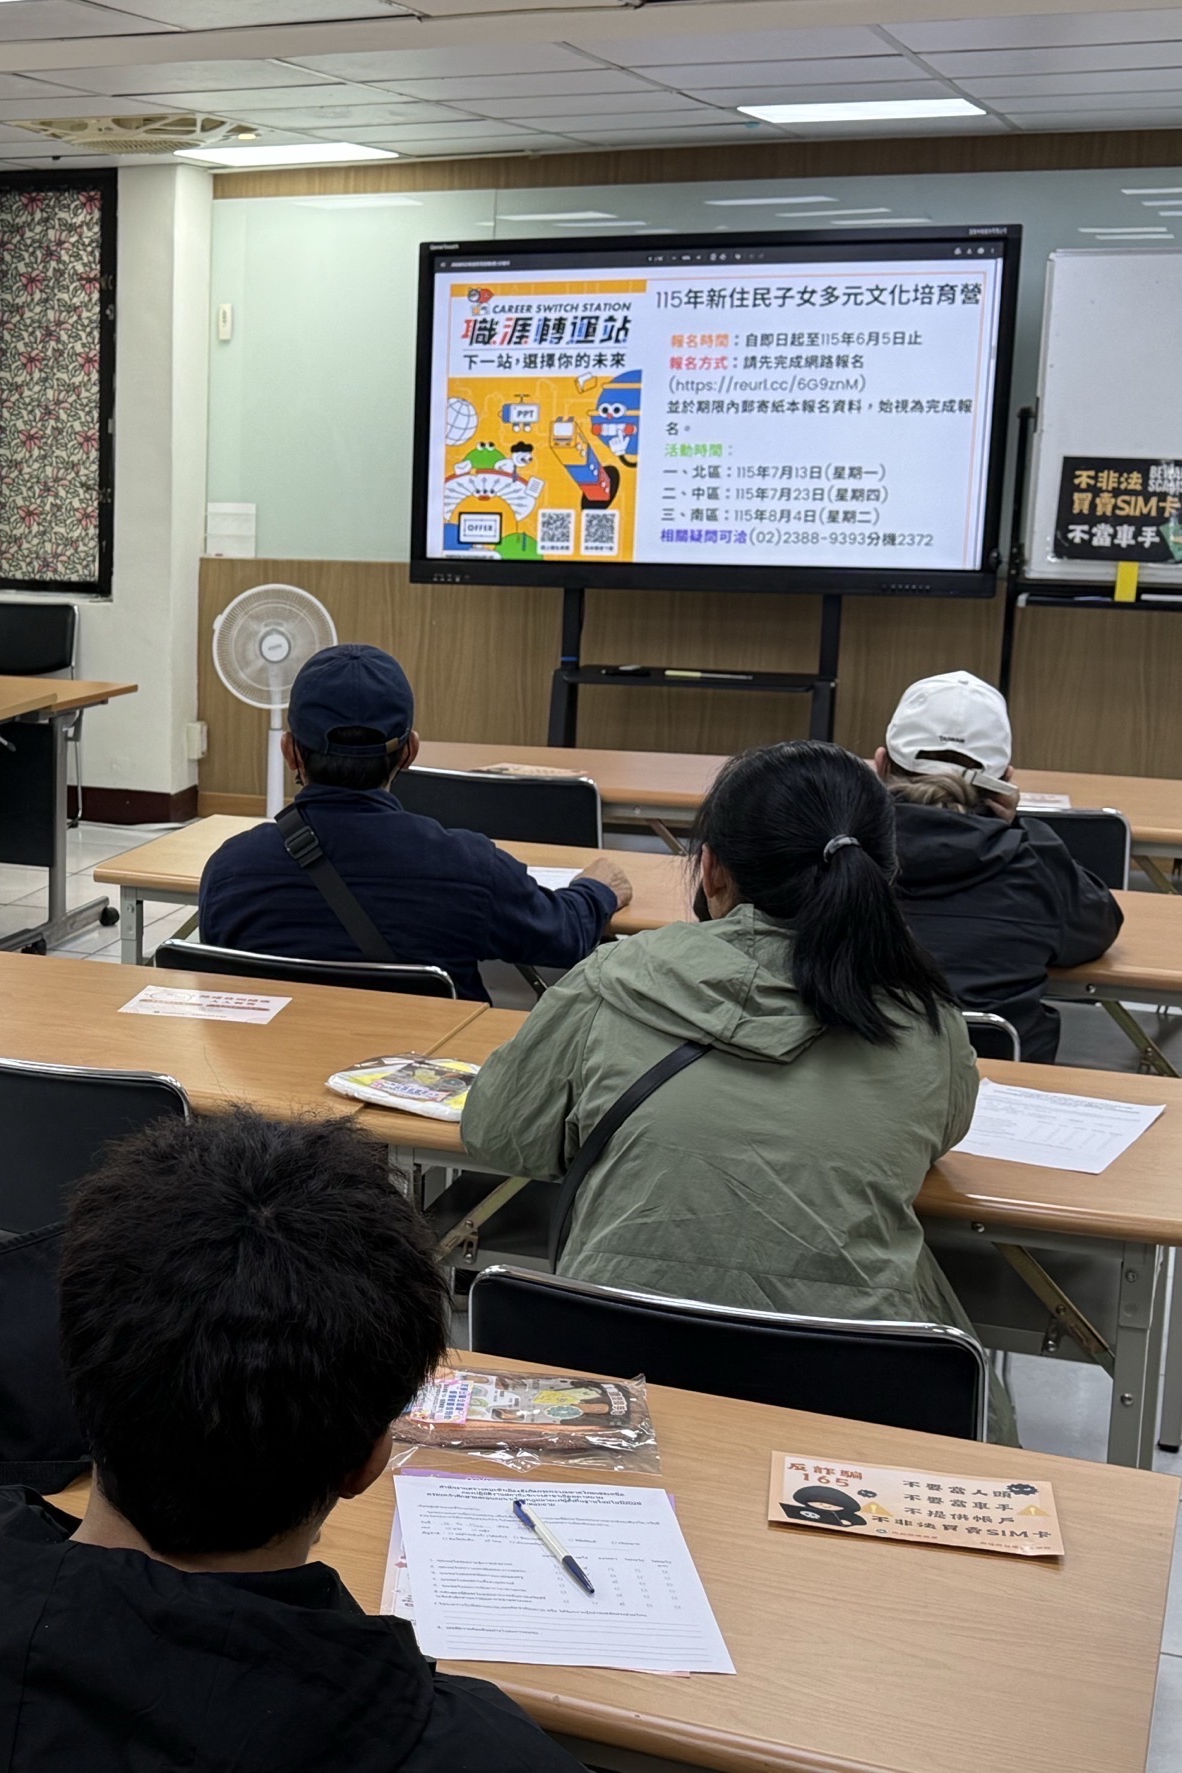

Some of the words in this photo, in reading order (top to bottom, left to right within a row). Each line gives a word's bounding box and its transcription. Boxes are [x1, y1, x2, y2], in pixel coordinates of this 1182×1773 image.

[656, 283, 982, 309] 115年新住民子女多元文化培育營
[492, 303, 532, 314] CAREER
[535, 302, 579, 313] SWITCH
[582, 302, 632, 312] STATION
[461, 315, 632, 345] 職涯轉運站
[517, 410, 534, 419] PPT
[1073, 469, 1142, 491] 不非法
[1072, 492, 1181, 518] 買賣SIM卡
[467, 524, 493, 532] OFFER
[1067, 523, 1160, 548] 不當車手
[787, 1462, 863, 1481] 反詐騙
[802, 1473, 850, 1487] 165
[902, 1480, 1012, 1499] 不要當人頭
[903, 1494, 1014, 1511] 不要當車手
